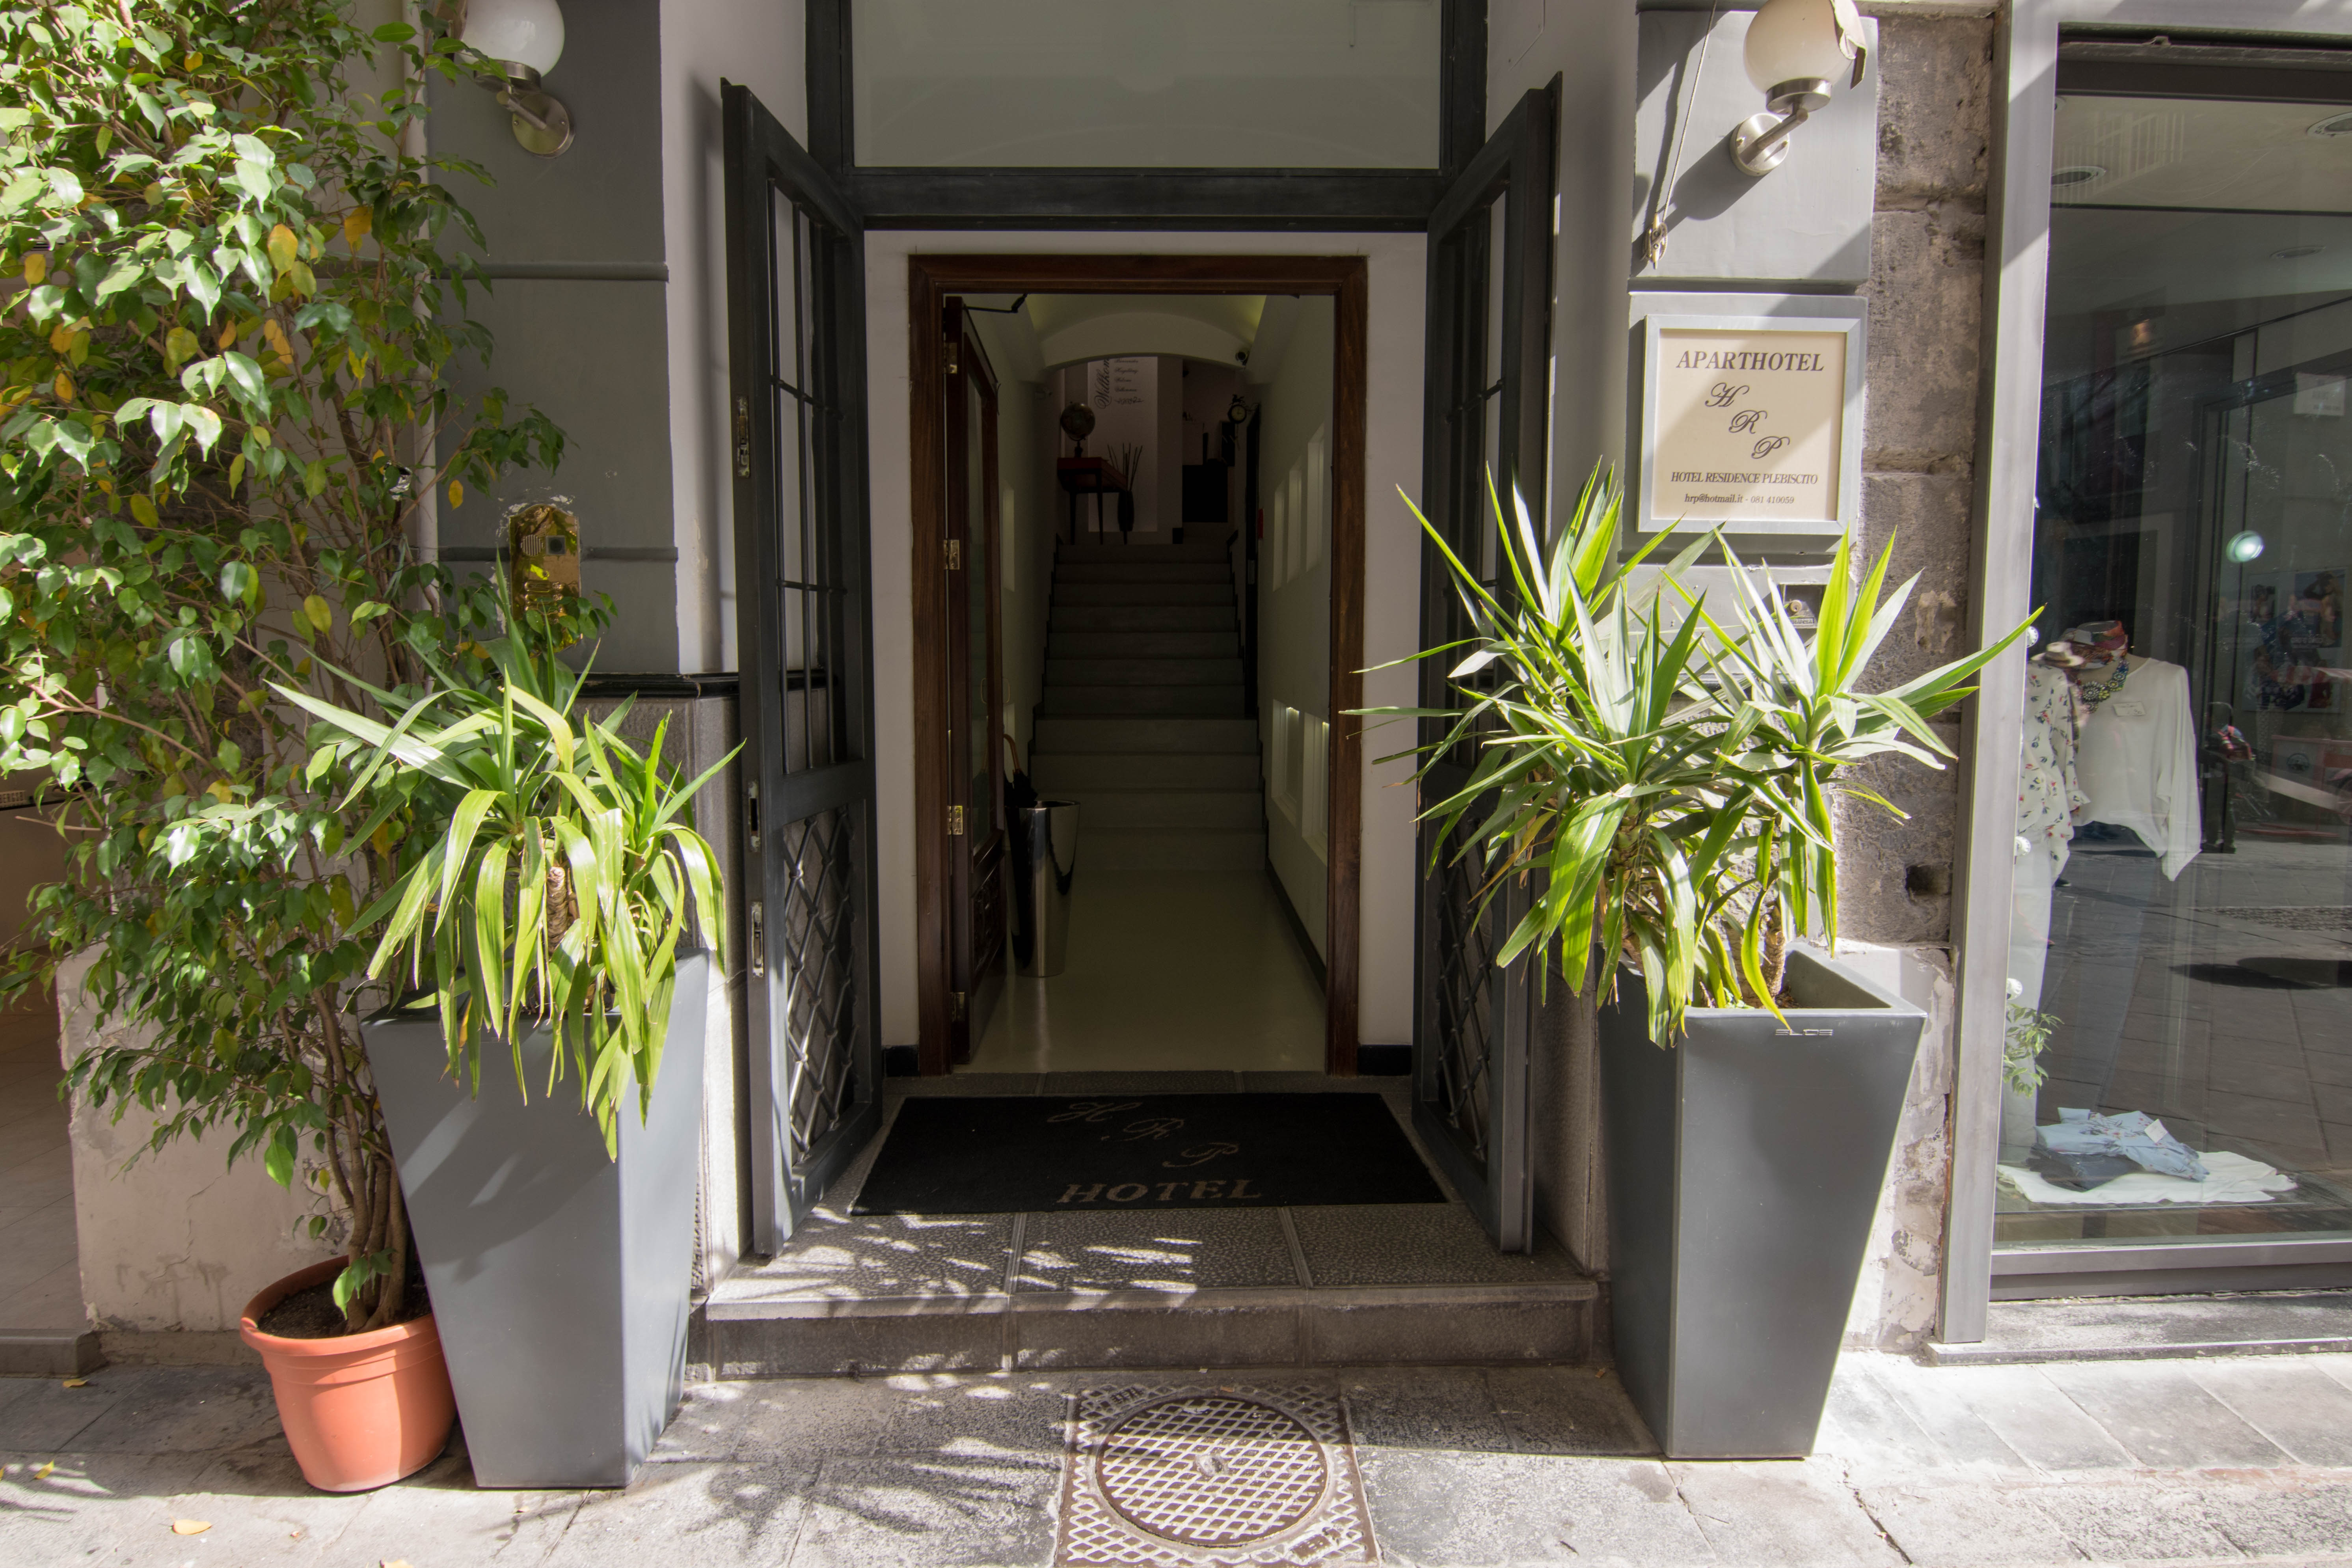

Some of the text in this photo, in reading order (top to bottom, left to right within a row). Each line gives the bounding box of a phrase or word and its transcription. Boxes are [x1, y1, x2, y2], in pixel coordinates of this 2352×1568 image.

[1676, 350, 1824, 371] APARTHOTEL
[1705, 382, 1750, 407] H
[1728, 410, 1767, 434] R
[1751, 436, 1790, 459] P
[1671, 471, 1818, 484] HOTEL RESIDENCE PLEBISCITO
[1684, 493, 1743, 504] hrp@hotmail.it
[1056, 1179, 1263, 1203] HOTEL
